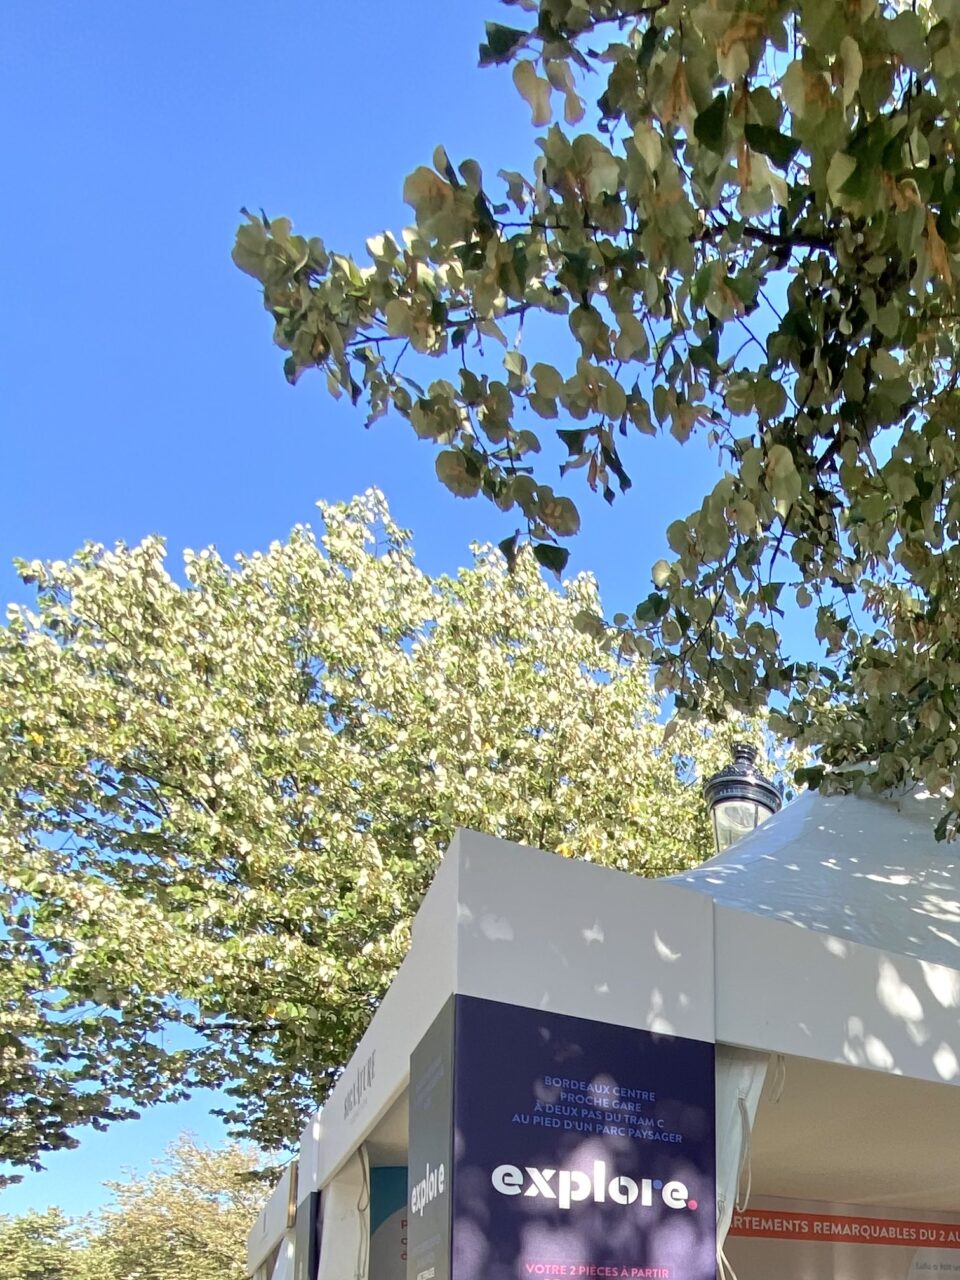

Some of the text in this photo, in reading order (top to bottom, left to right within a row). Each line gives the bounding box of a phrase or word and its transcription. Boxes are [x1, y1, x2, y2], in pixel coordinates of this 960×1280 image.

[544, 1075, 656, 1102] BORDEAUX CENTRE
[560, 1091, 642, 1112] PROCHE GARE
[512, 1113, 683, 1143] AU PIED D'UN PARC PAYSAGER
[545, 1104, 578, 1117] DEUX
[581, 1108, 601, 1120] PAS
[604, 1111, 621, 1122] DU
[623, 1114, 654, 1127] TRAM
[657, 1119, 664, 1128] C
[731, 1216, 809, 1232] RTEMENTS
[813, 1222, 916, 1240] REMARQUABLES
[919, 1229, 937, 1240] DU
[939, 1230, 945, 1242] 2
[526, 1263, 669, 1279] VOTRE 2 PIÈCES À PARTIR
